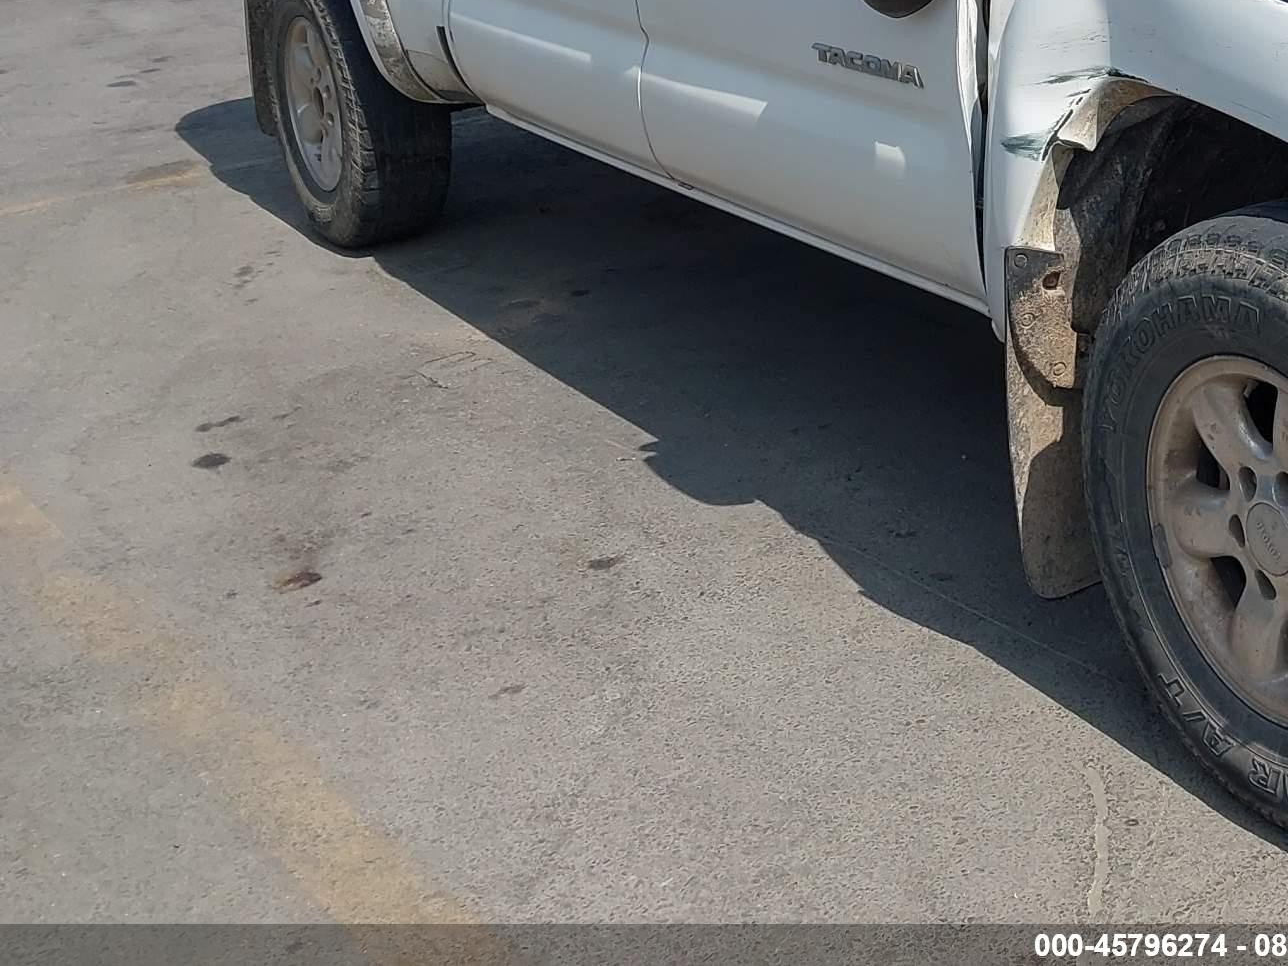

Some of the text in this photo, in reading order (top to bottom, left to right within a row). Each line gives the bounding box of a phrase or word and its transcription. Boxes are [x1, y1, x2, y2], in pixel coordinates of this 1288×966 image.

[811, 42, 925, 89] TACOMA
[1098, 294, 1265, 433] YOKOHAMA
[1157, 672, 1237, 757] A/T
